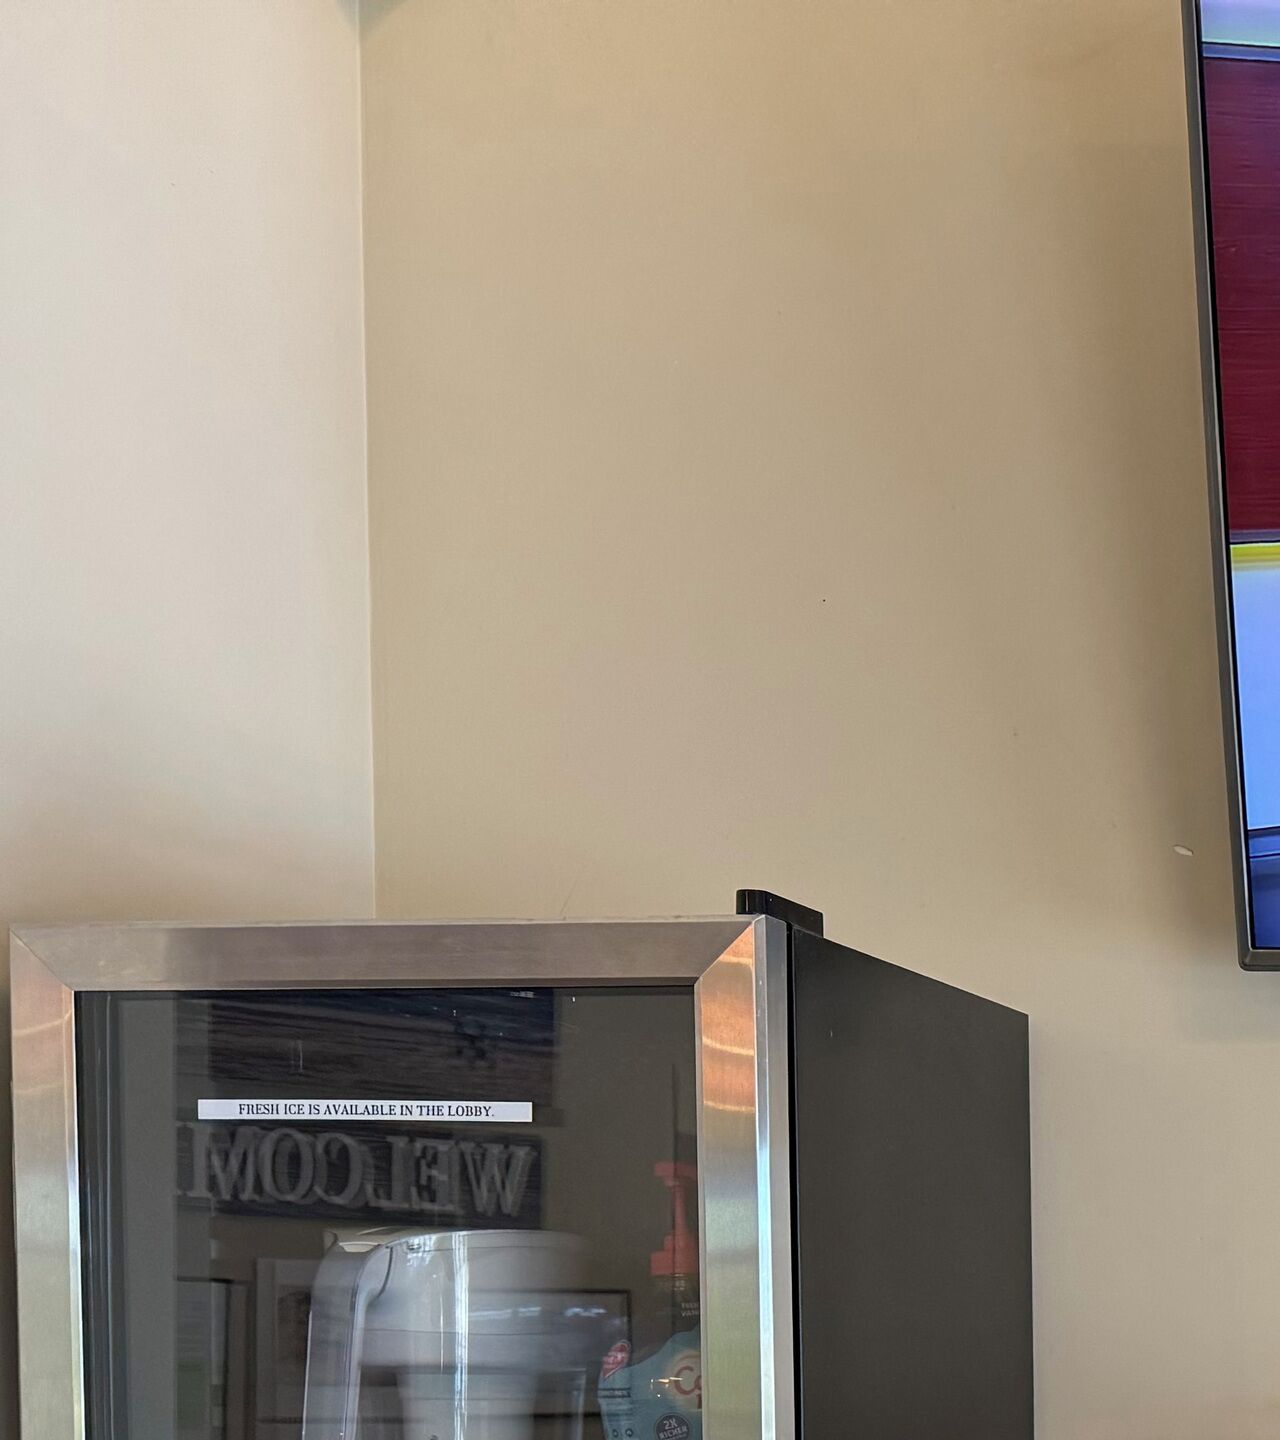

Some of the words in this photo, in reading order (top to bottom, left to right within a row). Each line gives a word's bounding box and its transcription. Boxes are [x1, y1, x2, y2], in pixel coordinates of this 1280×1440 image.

[238, 1103, 280, 1116] FRESH
[283, 1104, 305, 1117] ICE
[308, 1104, 321, 1117] IS
[323, 1104, 397, 1117] AVAILABLE
[400, 1104, 413, 1117] IN
[416, 1104, 445, 1117] THE
[447, 1104, 495, 1117] LOBBY.
